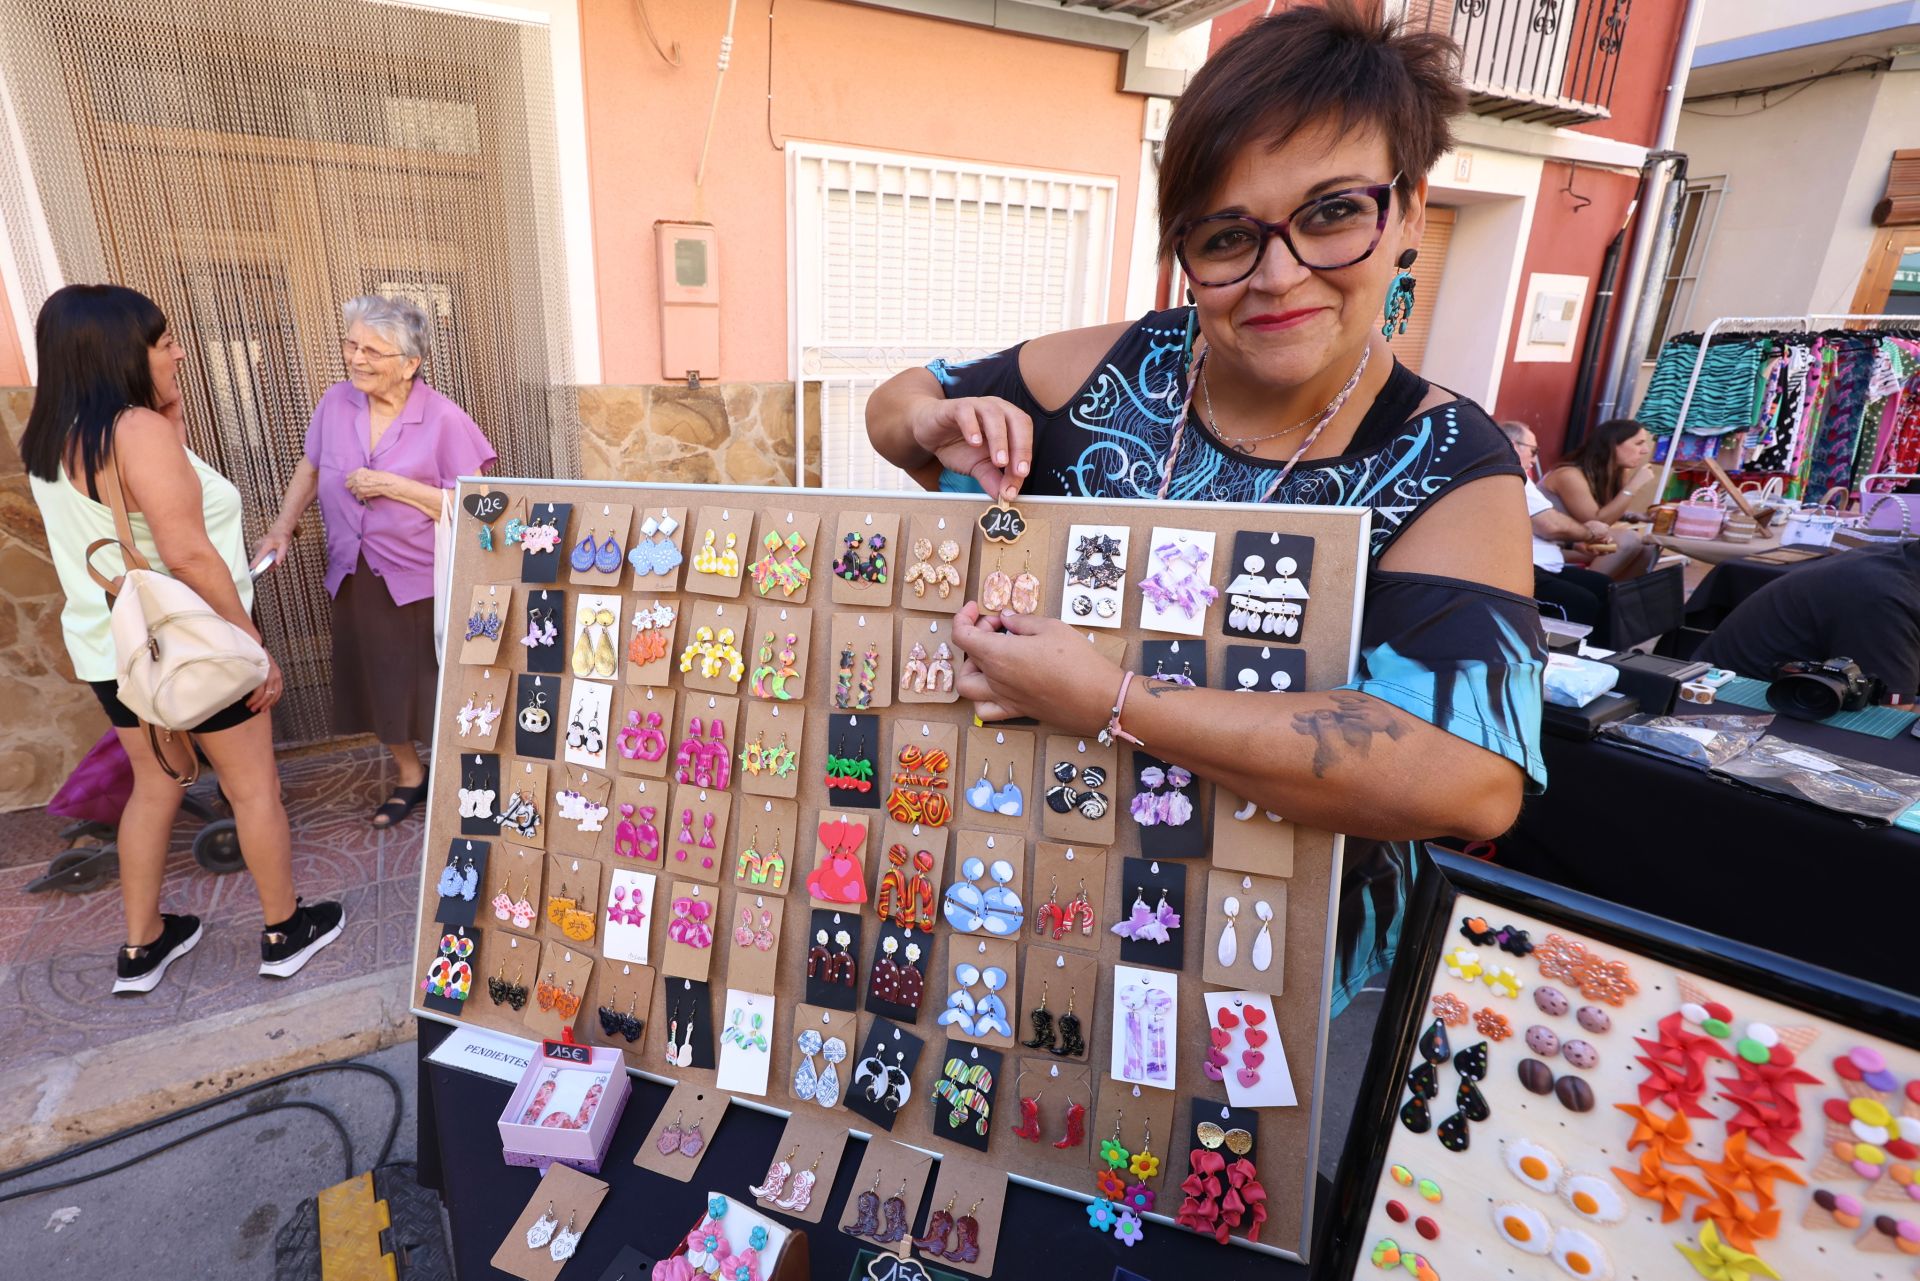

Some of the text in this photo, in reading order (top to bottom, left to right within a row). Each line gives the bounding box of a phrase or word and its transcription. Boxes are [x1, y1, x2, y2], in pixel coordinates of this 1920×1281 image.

[474, 497, 503, 516] 12€
[987, 513, 1021, 535] 12€
[463, 1044, 530, 1069] PENDIENTES
[549, 1045, 584, 1061] 15€
